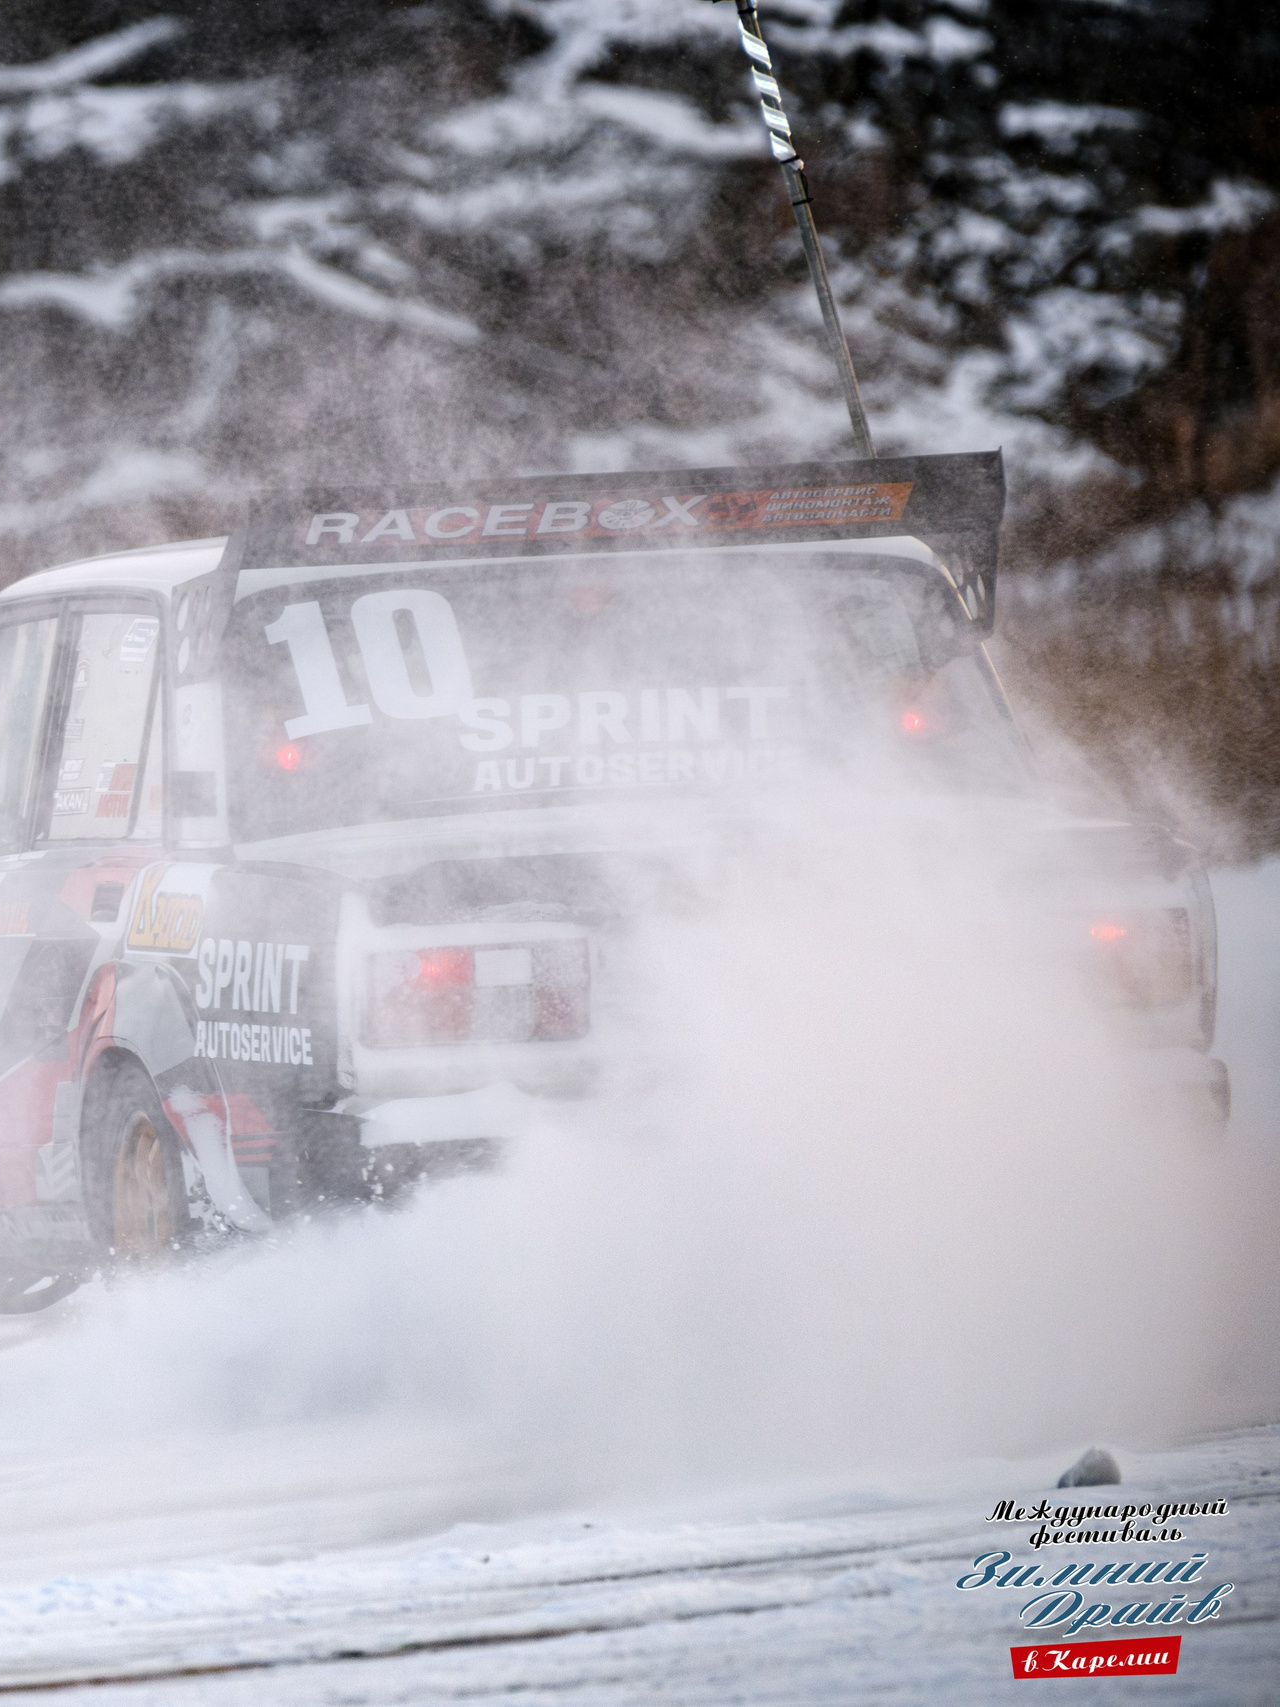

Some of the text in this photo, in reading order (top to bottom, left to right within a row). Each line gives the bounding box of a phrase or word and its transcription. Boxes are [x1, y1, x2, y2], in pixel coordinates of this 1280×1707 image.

[762, 507, 892, 522] АВТОЗАПЧАСТИ
[765, 495, 889, 511] ШИНОМОНТАЖ
[769, 486, 878, 500] АВТОСЕРВИС
[305, 494, 708, 545] RACEBOX
[264, 588, 474, 740] 10
[459, 686, 790, 752] SPRINT
[195, 938, 310, 1014] SPRINT
[193, 1020, 313, 1065] AUTOSERVICE
